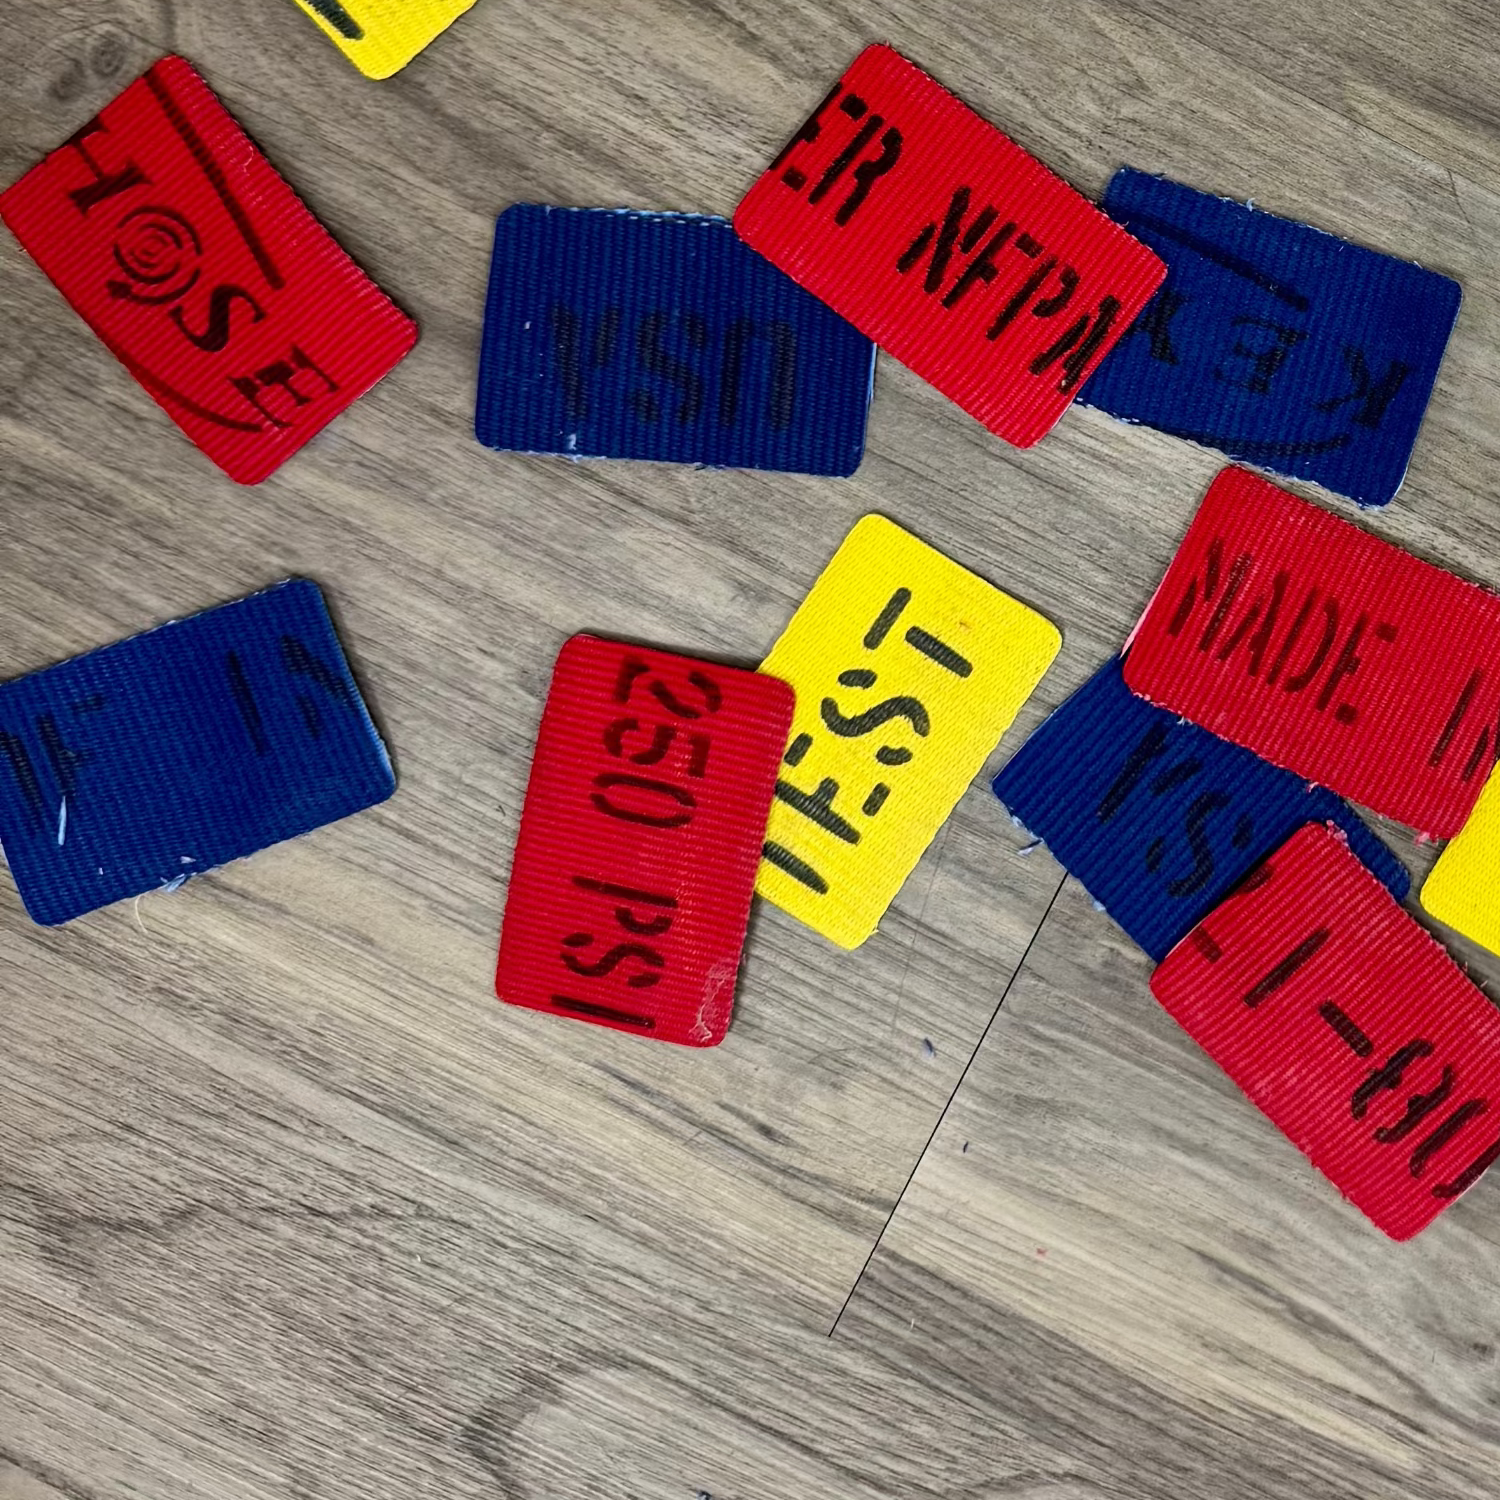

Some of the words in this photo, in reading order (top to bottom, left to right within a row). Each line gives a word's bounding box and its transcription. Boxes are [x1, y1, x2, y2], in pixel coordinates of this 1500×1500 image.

[43, 116, 340, 428] HOSE
[896, 186, 1122, 396] NFPA
[552, 301, 795, 431] USA
[1168, 538, 1398, 724] MADE
[590, 654, 724, 829] 250
[551, 875, 679, 1030] PSI
